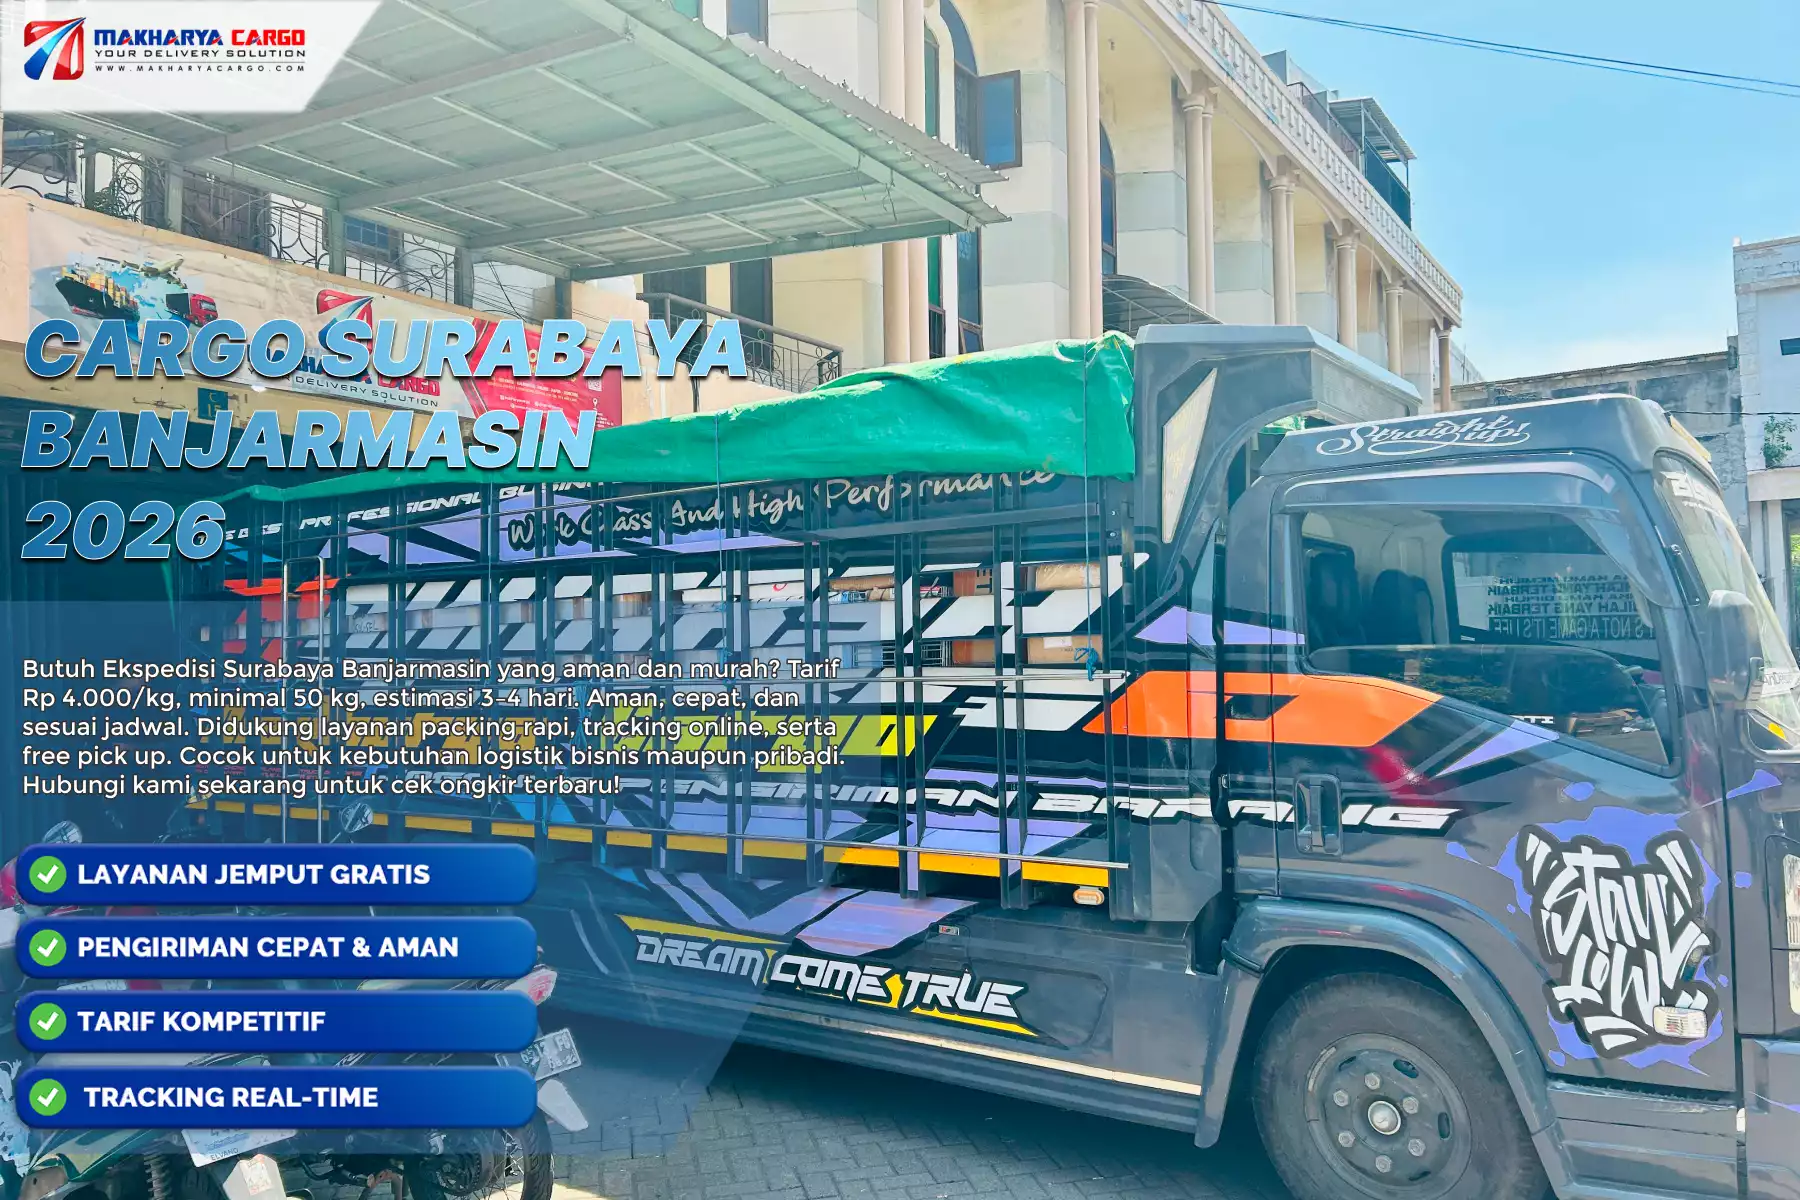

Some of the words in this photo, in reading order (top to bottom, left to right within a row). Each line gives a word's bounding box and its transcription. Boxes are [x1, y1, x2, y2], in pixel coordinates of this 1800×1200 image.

[295, 375, 367, 395] DELIVERY
[371, 389, 438, 408] SOLUTION
[1316, 415, 1509, 456] Straight
[299, 491, 483, 530] PRFESSIONAL
[635, 934, 766, 986] DREAM
[770, 955, 893, 1002] COME
[901, 970, 1025, 1018] TRUE
